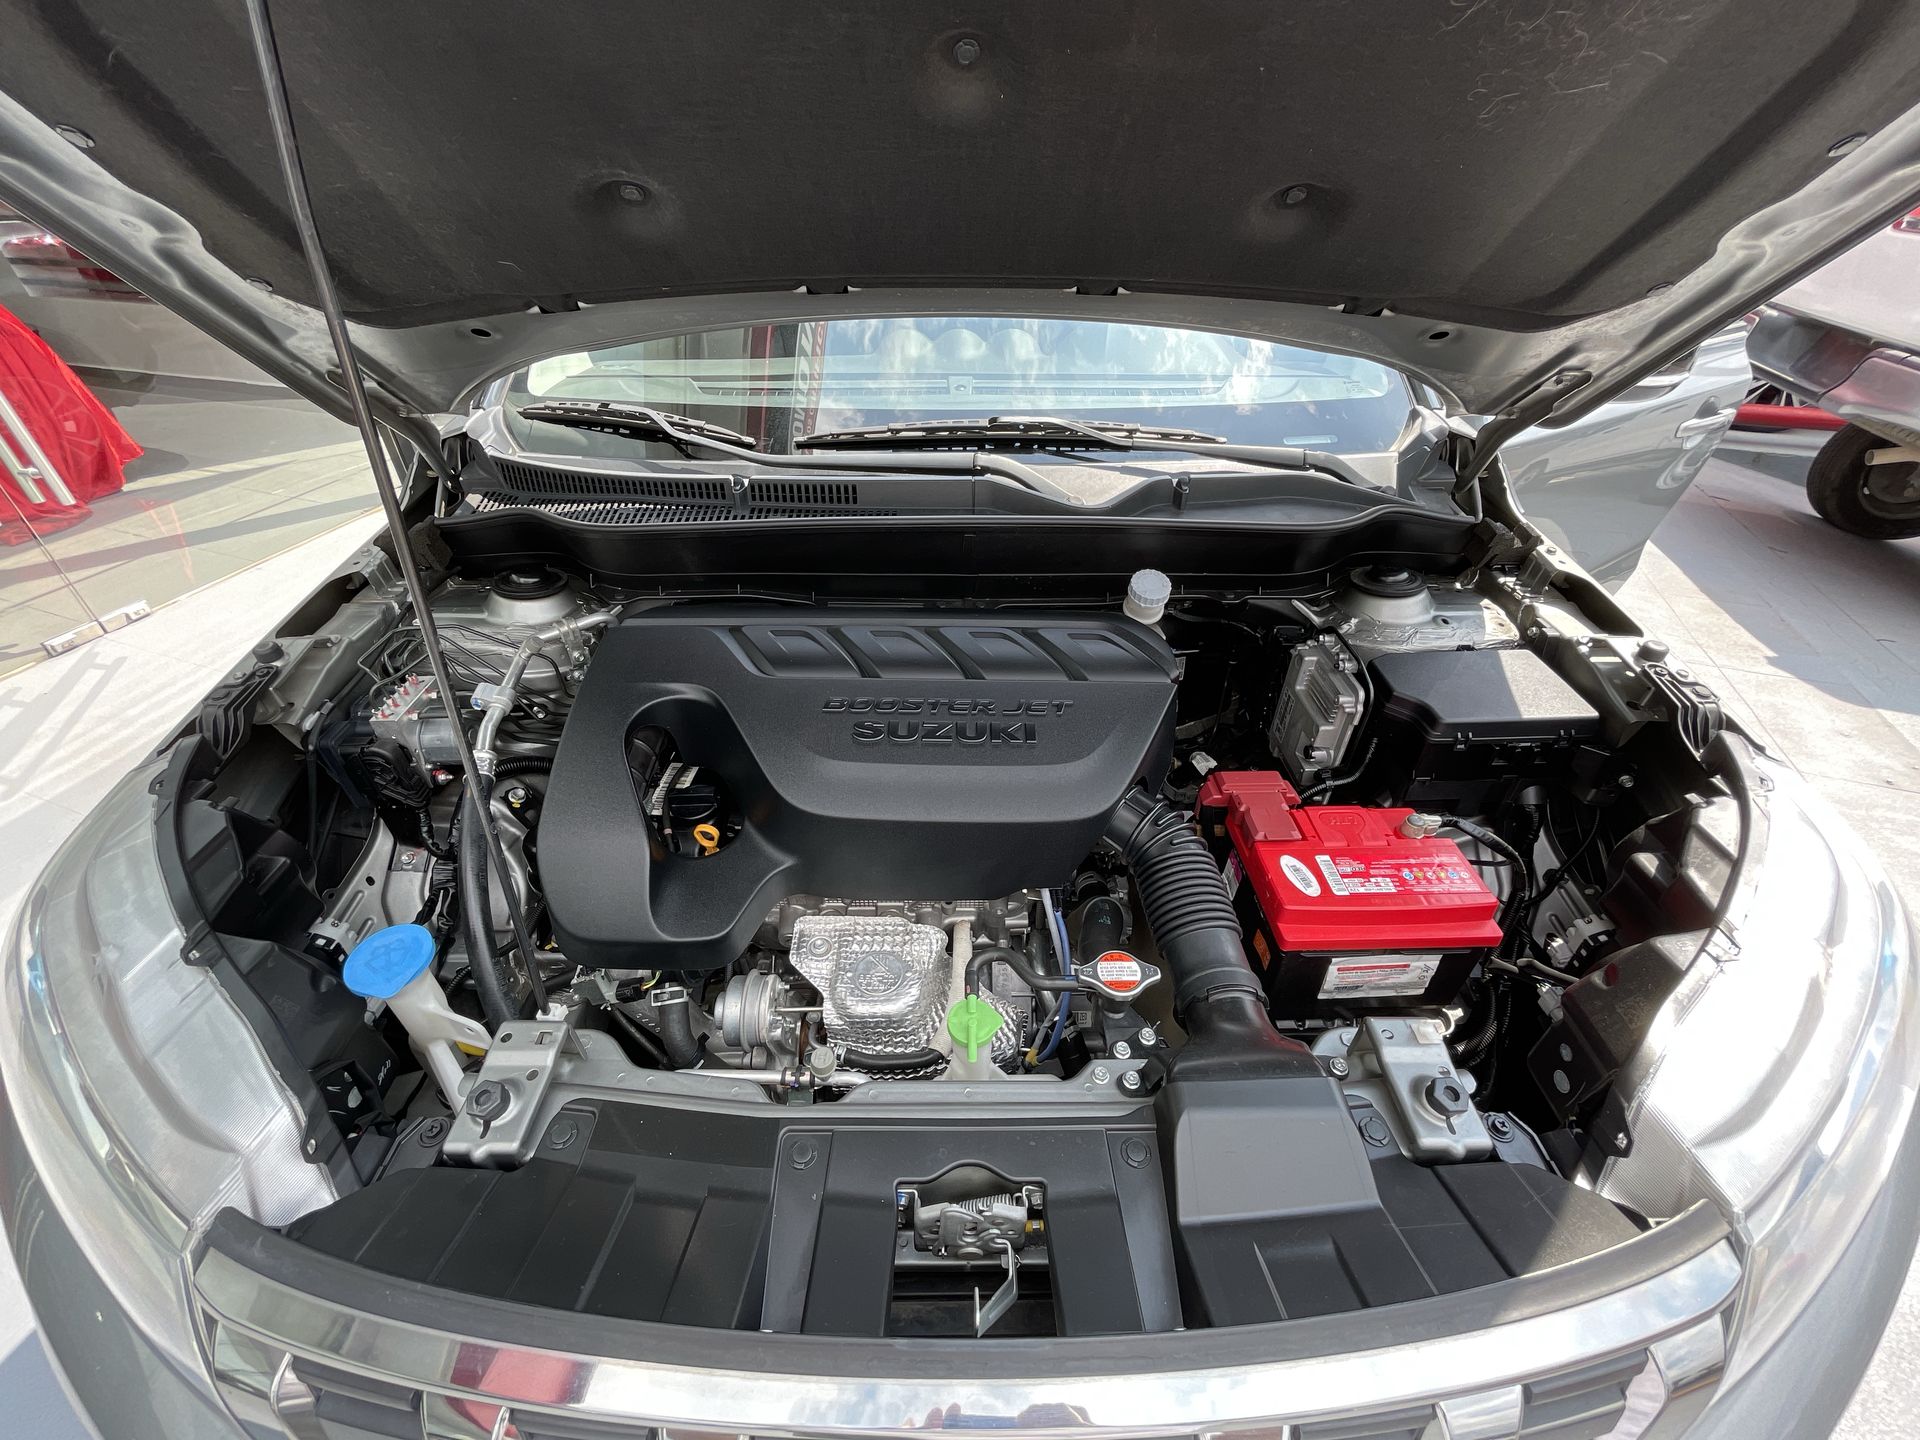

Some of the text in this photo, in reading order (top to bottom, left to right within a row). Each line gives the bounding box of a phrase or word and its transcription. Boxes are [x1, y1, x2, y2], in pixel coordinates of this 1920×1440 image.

[822, 697, 1074, 716] BOOSTER JET
[851, 720, 1037, 744] SUZUKI
